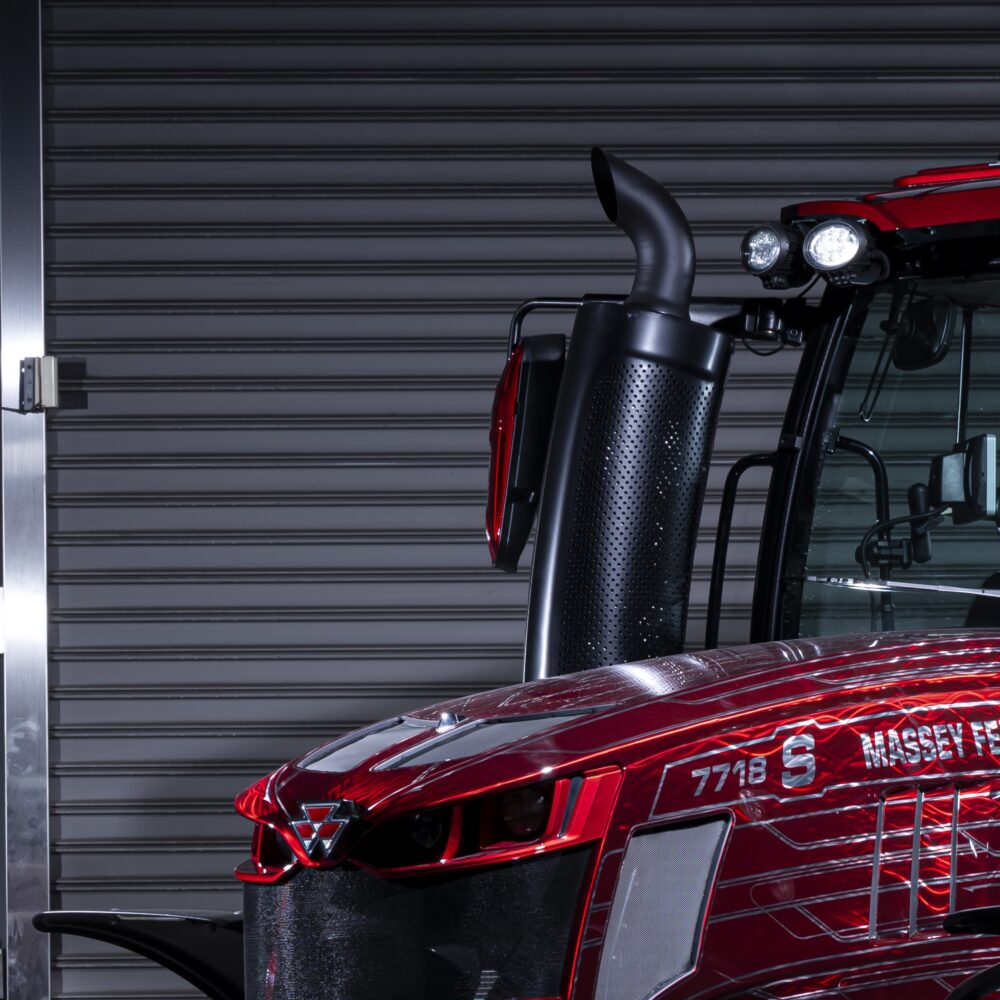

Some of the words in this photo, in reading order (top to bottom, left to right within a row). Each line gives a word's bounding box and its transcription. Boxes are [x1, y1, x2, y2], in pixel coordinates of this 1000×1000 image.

[691, 756, 767, 797] 7718
[781, 733, 816, 789] S
[859, 722, 965, 769] MASSEY
